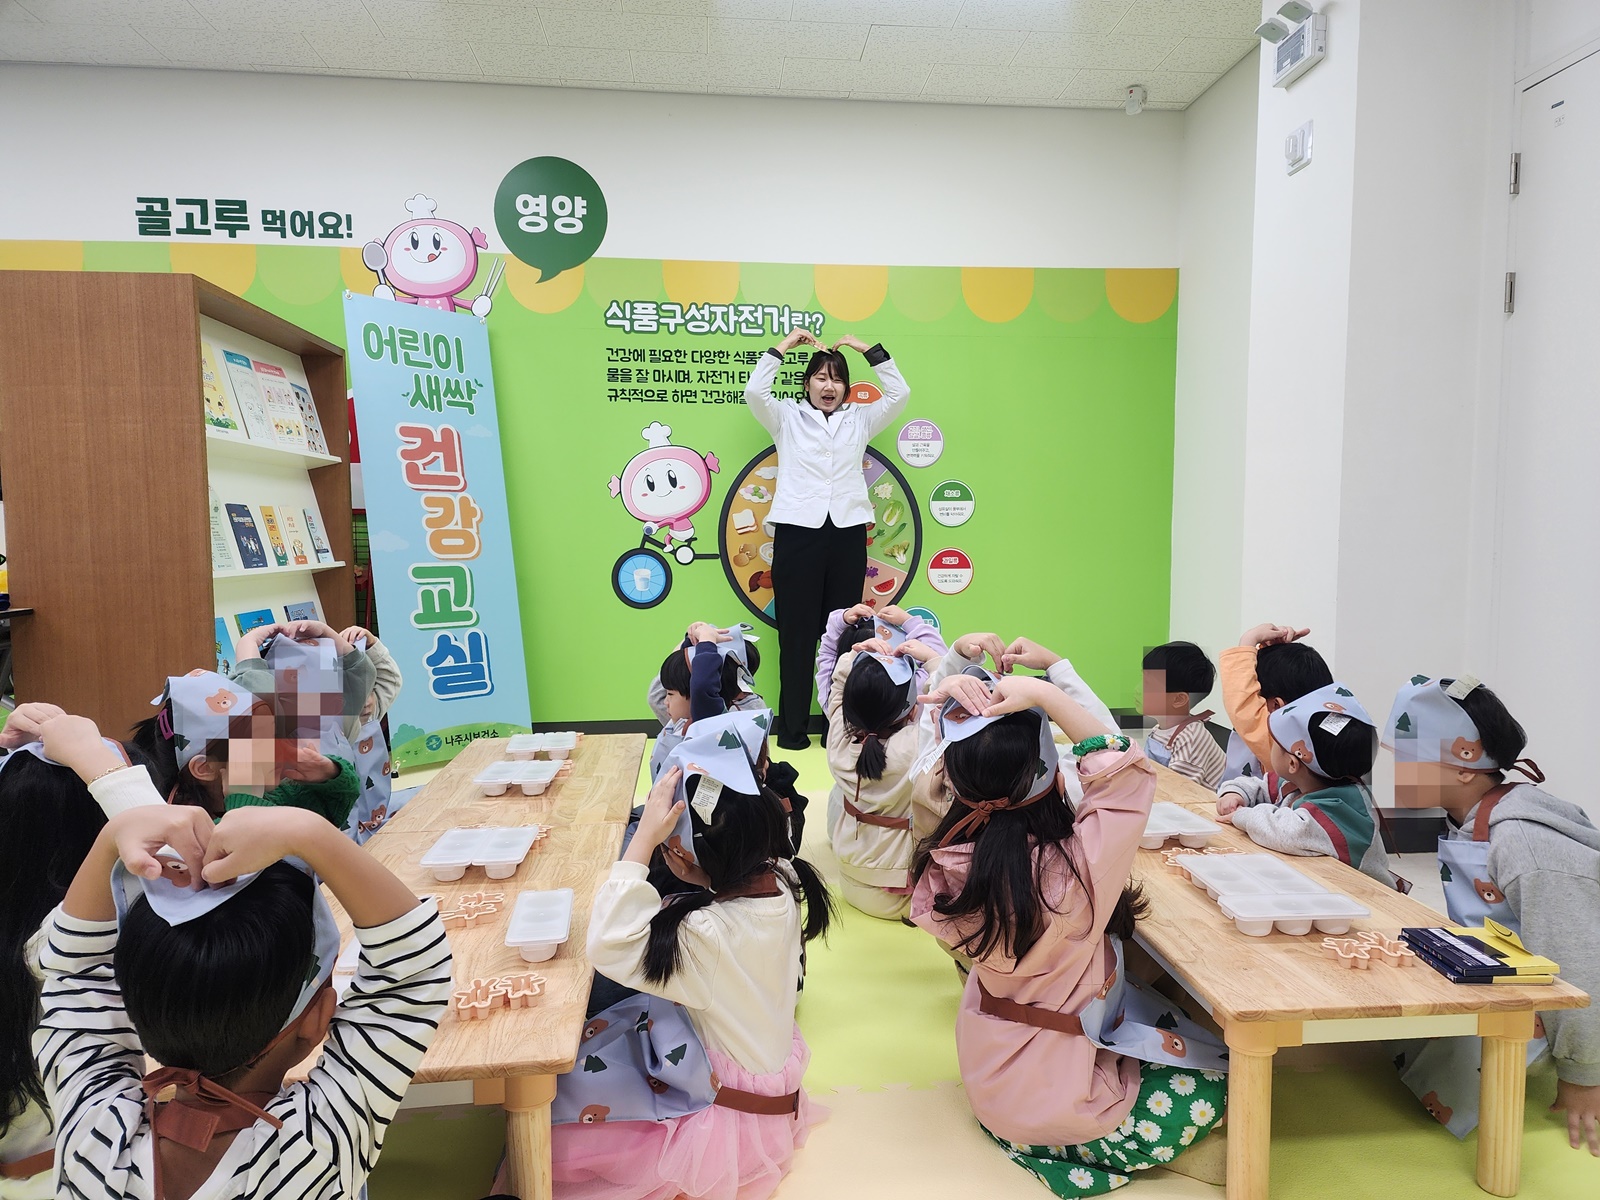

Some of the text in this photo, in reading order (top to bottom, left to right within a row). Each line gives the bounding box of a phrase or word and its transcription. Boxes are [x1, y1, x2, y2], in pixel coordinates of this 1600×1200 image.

[135, 196, 353, 240] 골고루 먹어요!
[515, 193, 588, 234] 영양
[605, 301, 824, 336] 식품구성자전거란?
[363, 322, 465, 374] 어린이
[606, 348, 646, 363] 건강에
[648, 349, 688, 364] 필요한
[691, 349, 731, 365] 다양한
[780, 351, 809, 366] 고루
[409, 374, 477, 415] 새싹
[606, 367, 633, 384] 물을
[635, 368, 650, 384] 잘
[652, 369, 694, 385] 마시며,
[697, 370, 735, 385] 자전거
[780, 371, 805, 386] 같은
[606, 388, 669, 404] 규칙적으로
[671, 389, 698, 404] 하면
[396, 423, 494, 701] 건강교실
